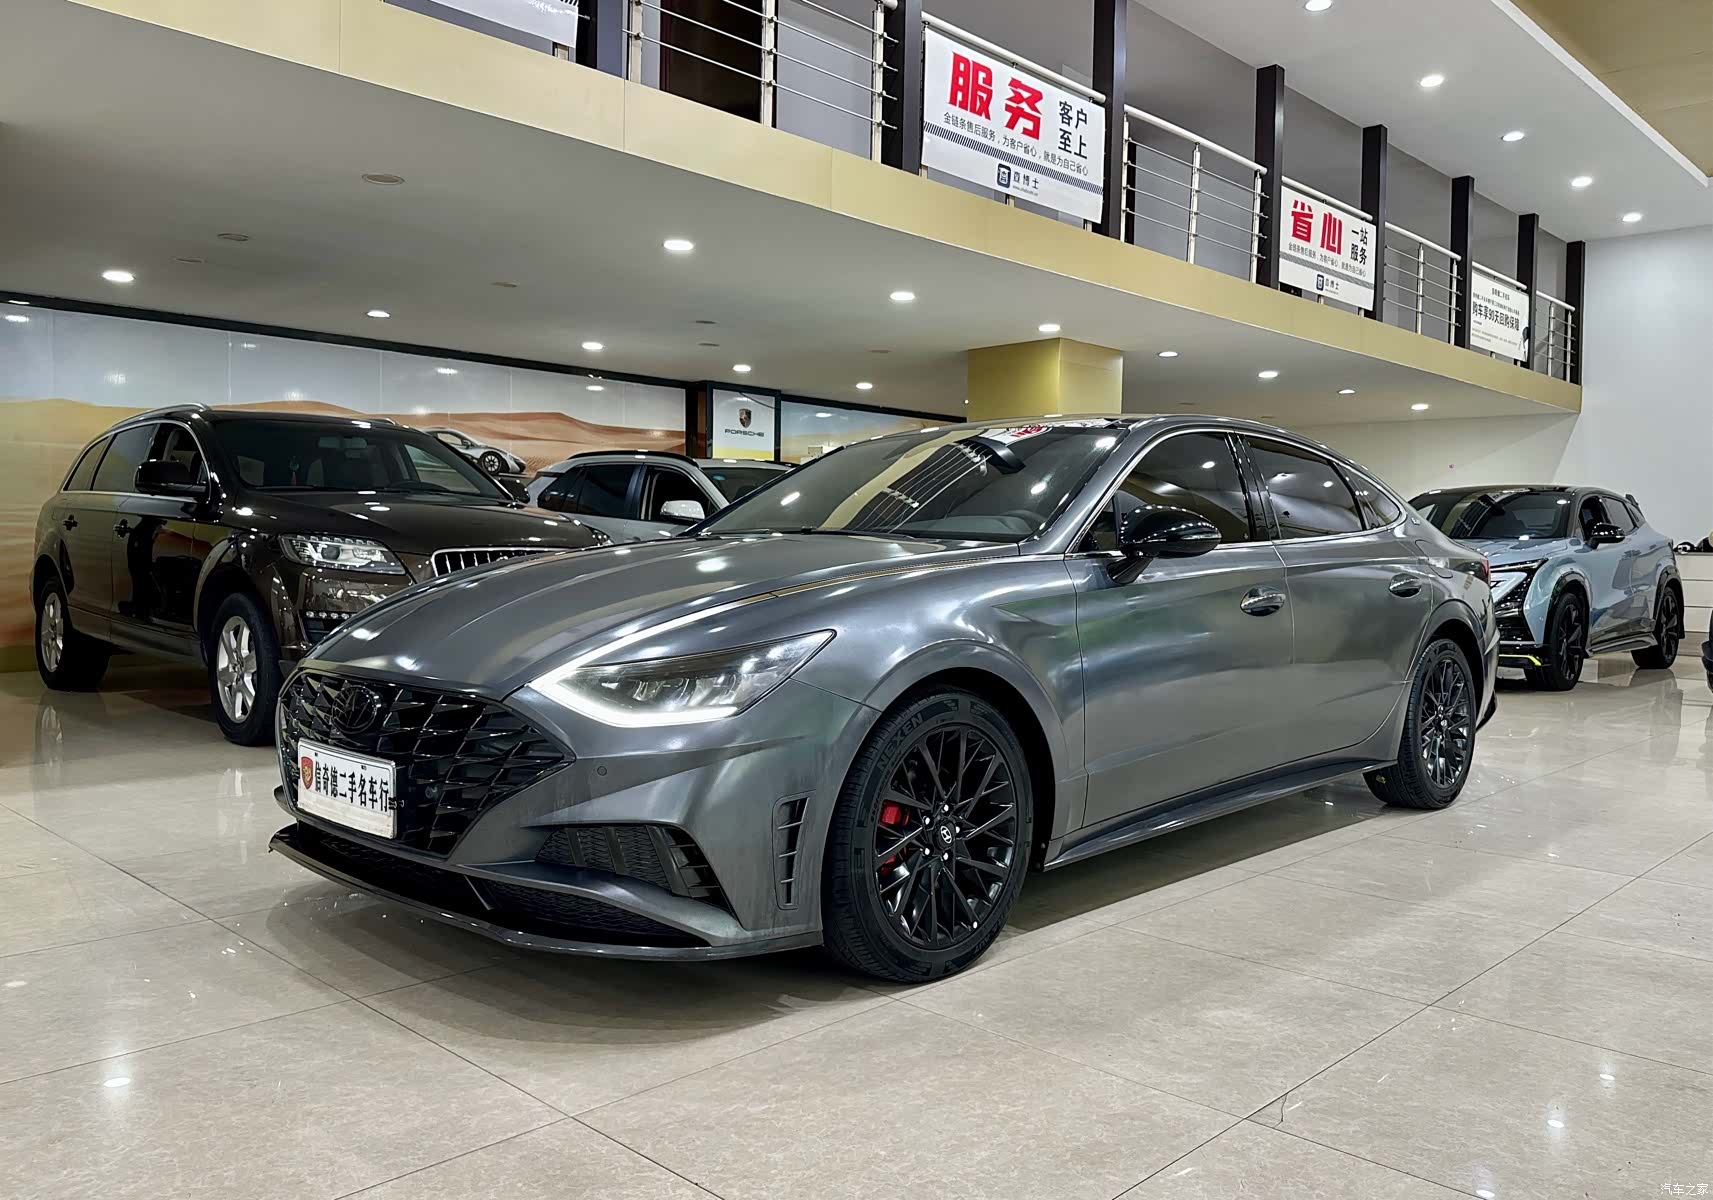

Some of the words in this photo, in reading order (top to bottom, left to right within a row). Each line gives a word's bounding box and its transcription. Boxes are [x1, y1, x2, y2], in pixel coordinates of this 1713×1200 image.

[948, 51, 1044, 140] 服务
[1059, 101, 1088, 129] 客户
[1058, 128, 1088, 160] 至上
[1291, 199, 1343, 256] 省心
[1351, 226, 1368, 246] 一站
[1350, 243, 1368, 265] 服务
[725, 429, 764, 437] PORSCHE
